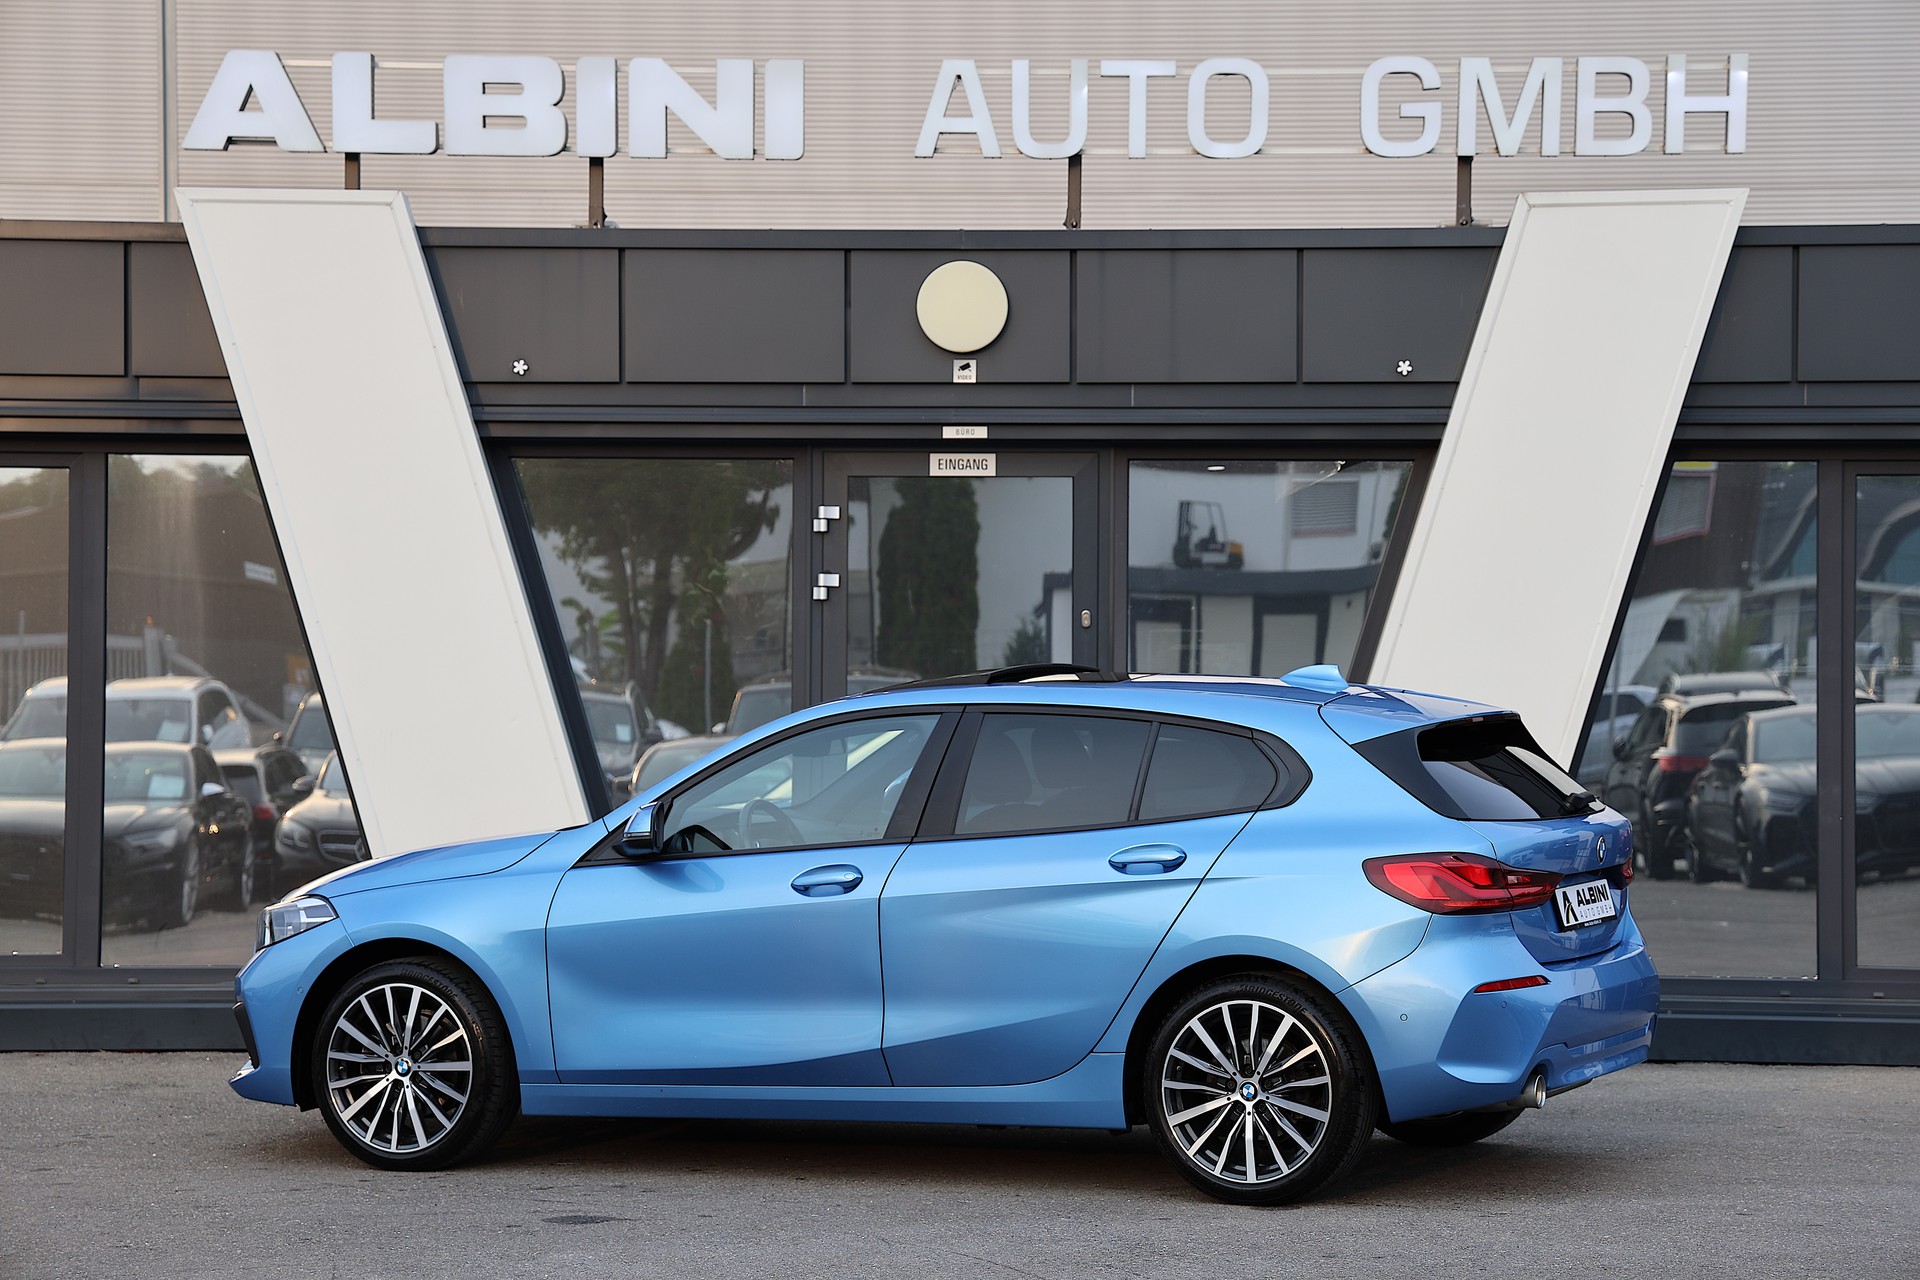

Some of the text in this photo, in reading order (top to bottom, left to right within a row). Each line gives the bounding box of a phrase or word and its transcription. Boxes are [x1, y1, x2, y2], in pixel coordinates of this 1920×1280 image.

[181, 50, 1750, 161] ALBINI AUTO GMBH
[937, 458, 989, 471] EINGANG
[1576, 884, 1609, 907] ALBINI
[1238, 984, 1308, 1014] BRIDGESTONE
